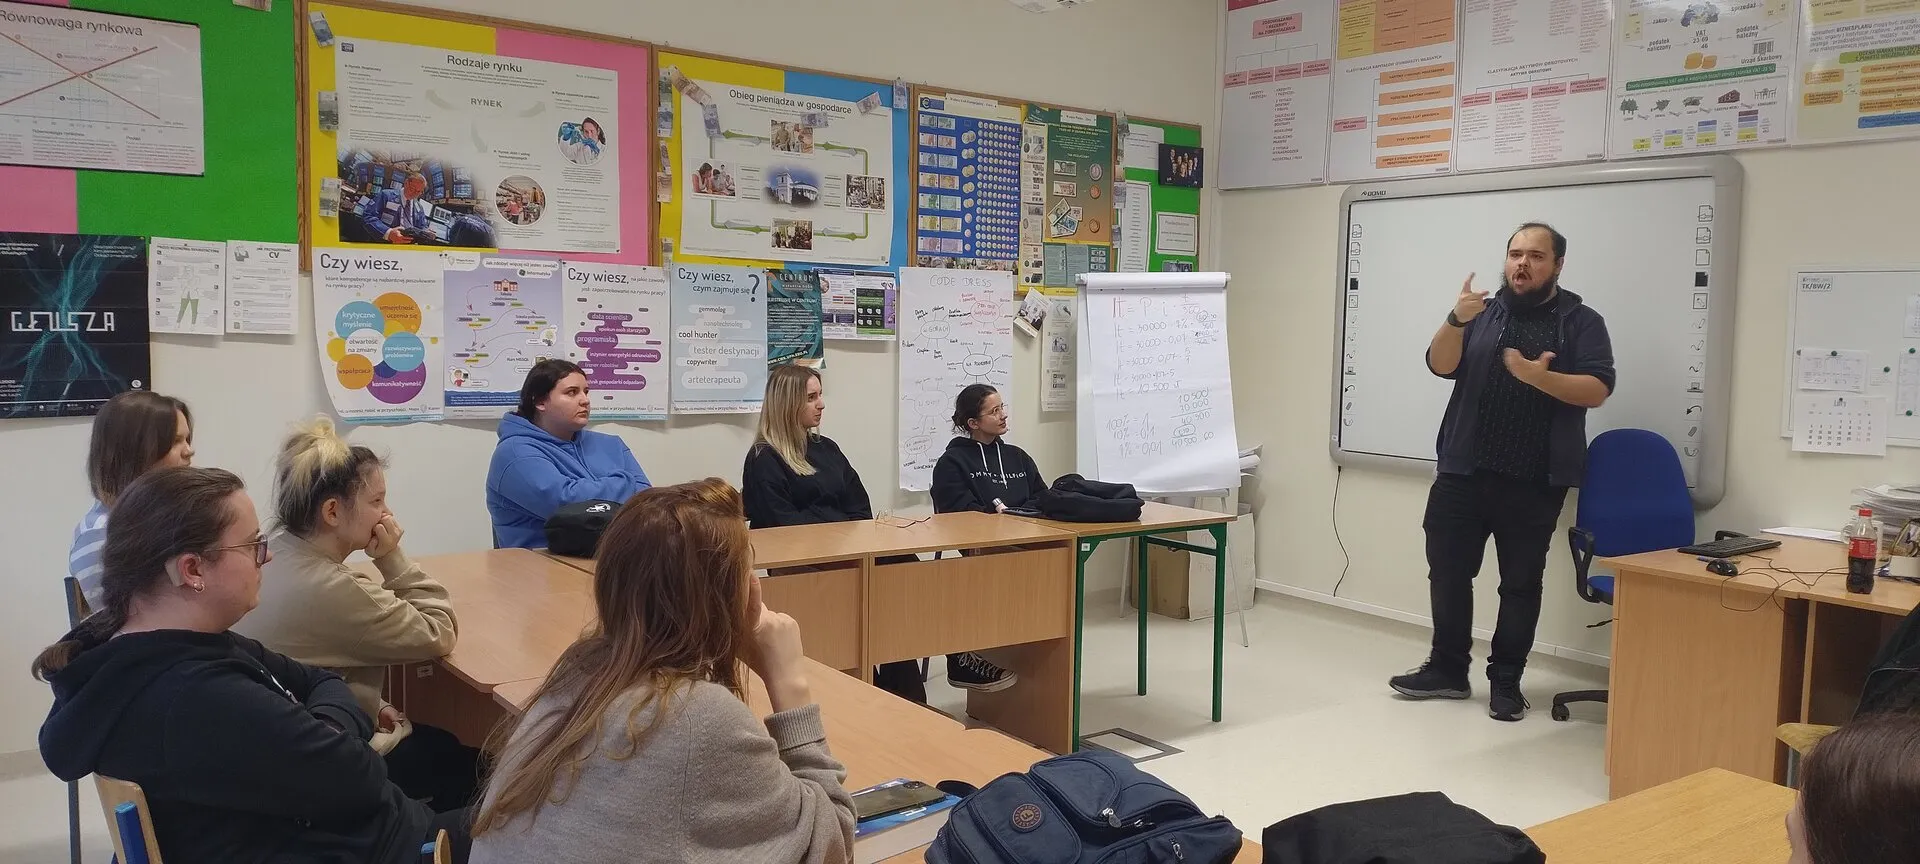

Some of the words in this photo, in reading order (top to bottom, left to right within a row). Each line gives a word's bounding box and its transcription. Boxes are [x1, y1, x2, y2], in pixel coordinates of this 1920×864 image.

[1731, 3, 1756, 12] sprzedaż
[86, 21, 143, 36] rynkowa
[1736, 24, 1759, 34] podatek
[1648, 38, 1670, 46] podatek
[1646, 44, 1672, 52] naliczony
[447, 54, 490, 70] Rodzaje
[493, 61, 522, 73] rynku
[1757, 54, 1782, 62] Skarbowy
[470, 98, 502, 108] RYNEK
[729, 89, 754, 102] Obieg
[757, 94, 794, 107] pieniądza
[806, 102, 851, 114] gospodarce
[320, 253, 349, 273] Czy
[354, 256, 403, 272] wiesz,
[568, 268, 590, 284] Czy
[593, 270, 629, 284] wiesz,
[678, 267, 698, 283] Czy
[702, 270, 734, 283] wiesz,
[930, 275, 955, 287] CODE
[962, 277, 992, 287] DRESS
[693, 285, 711, 293] czym
[713, 285, 739, 295] zajmuje
[748, 274, 760, 302] ?
[1140, 297, 1152, 318] P
[342, 311, 376, 319] krytyczne
[577, 335, 616, 343] programista
[718, 347, 760, 357] destynacji
[688, 377, 741, 385] arteterapeuta
[1178, 394, 1190, 403] 10
[1192, 389, 1209, 399] 500
